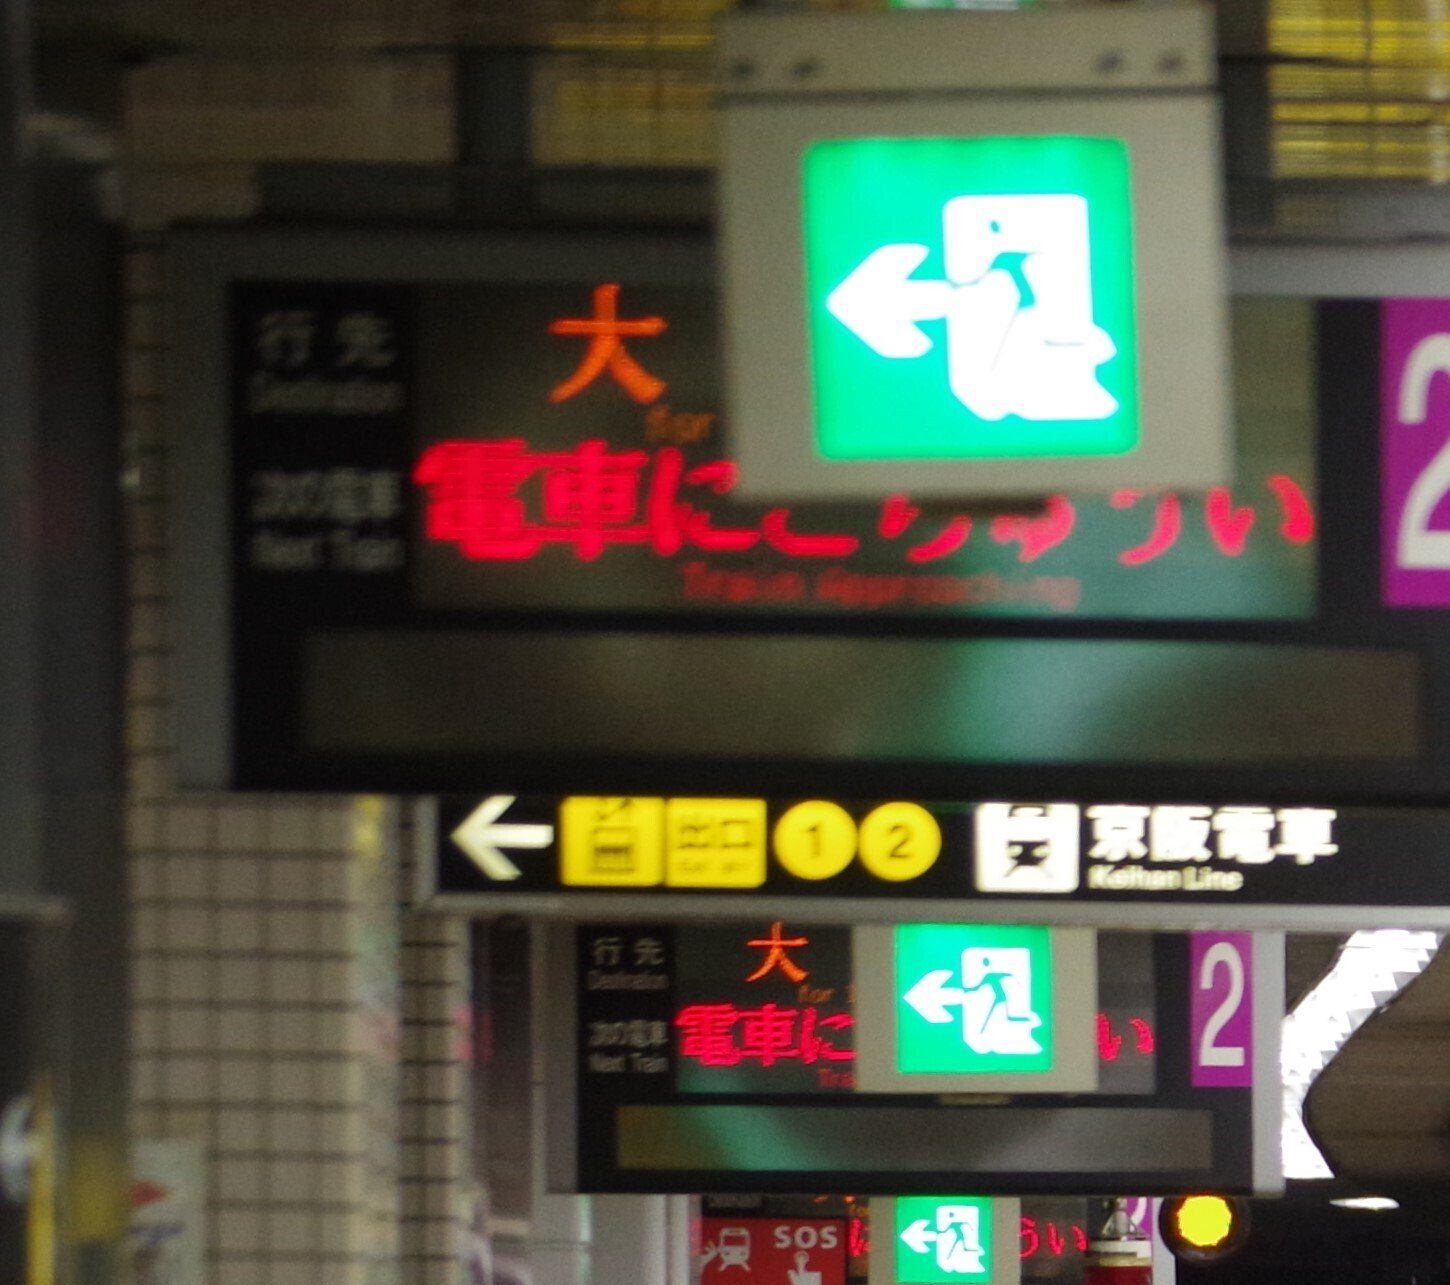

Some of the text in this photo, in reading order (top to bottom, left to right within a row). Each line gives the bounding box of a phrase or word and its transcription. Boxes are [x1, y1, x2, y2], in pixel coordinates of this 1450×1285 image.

[548, 275, 668, 404] 大
[804, 821, 824, 861] 1
[888, 821, 919, 861] 2
[1086, 804, 1339, 865] 京阪電車
[1086, 863, 1244, 892] Keihan Line
[745, 920, 811, 982] 大
[1200, 941, 1246, 1067] 2
[773, 1225, 839, 1249] SOS
